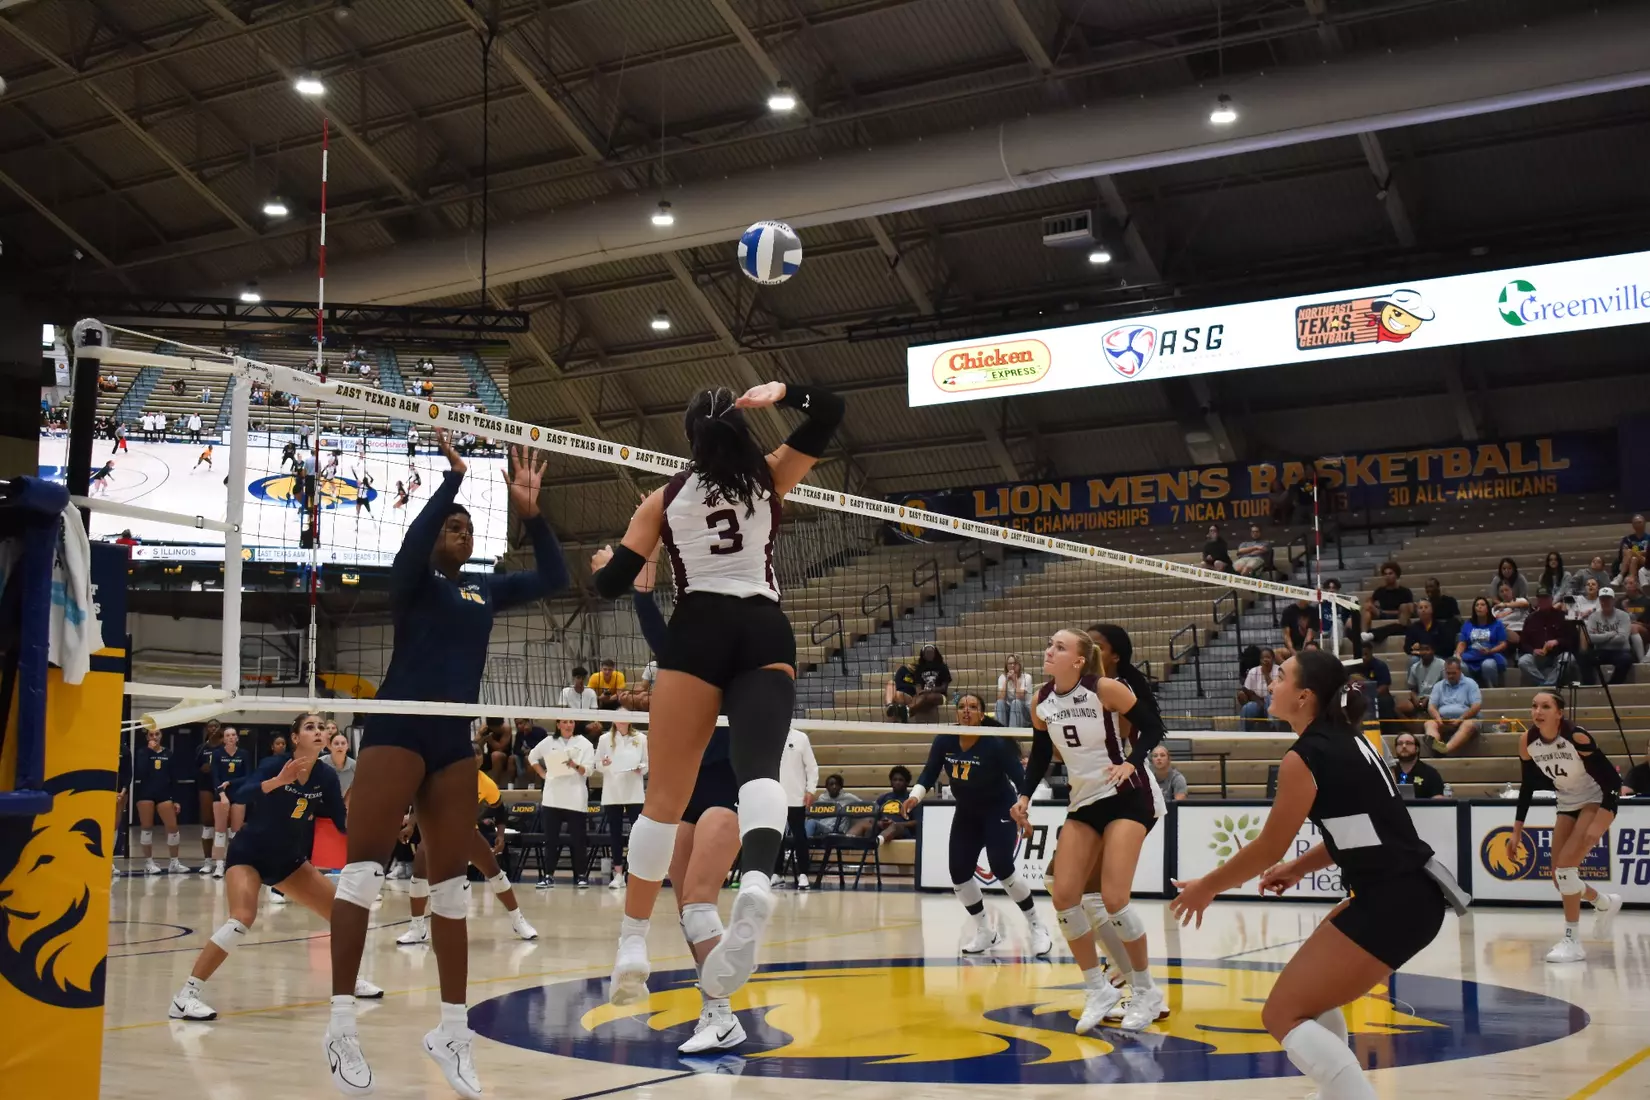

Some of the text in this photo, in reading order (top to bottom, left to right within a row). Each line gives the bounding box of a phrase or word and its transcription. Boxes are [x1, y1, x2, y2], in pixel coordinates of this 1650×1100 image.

[1298, 303, 1353, 320] NORTHEAST
[1520, 284, 1650, 322] Greenville
[1300, 314, 1352, 335] TEXAS
[1159, 324, 1224, 356] ASG
[1300, 332, 1354, 347] GELLYBALL
[949, 349, 1034, 371] Chicken
[991, 366, 1036, 379] EXPRESS
[336, 384, 420, 414] EAST TEXAS A&M
[448, 410, 522, 436] EAST TEXAS A&M
[546, 433, 614, 456] EAST TEXAS A&M
[636, 452, 653, 464] EAST
[656, 456, 678, 468] TEXAS
[972, 438, 1570, 518] LION MEN'S BASKETBALL
[803, 489, 821, 500] TEXAS
[1034, 507, 1148, 534] CHAMPIONSHIPS
[1170, 507, 1179, 523] 7
[1185, 502, 1225, 522] NCAA
[1388, 488, 1410, 506] 30
[1415, 475, 1557, 505] ALL-AMERICANS
[706, 509, 743, 554] 3
[152, 548, 196, 556] S ILLINOIS
[1062, 725, 1081, 748] 9
[952, 763, 971, 780] 17
[1546, 764, 1568, 778] 14
[290, 798, 308, 818] 2
